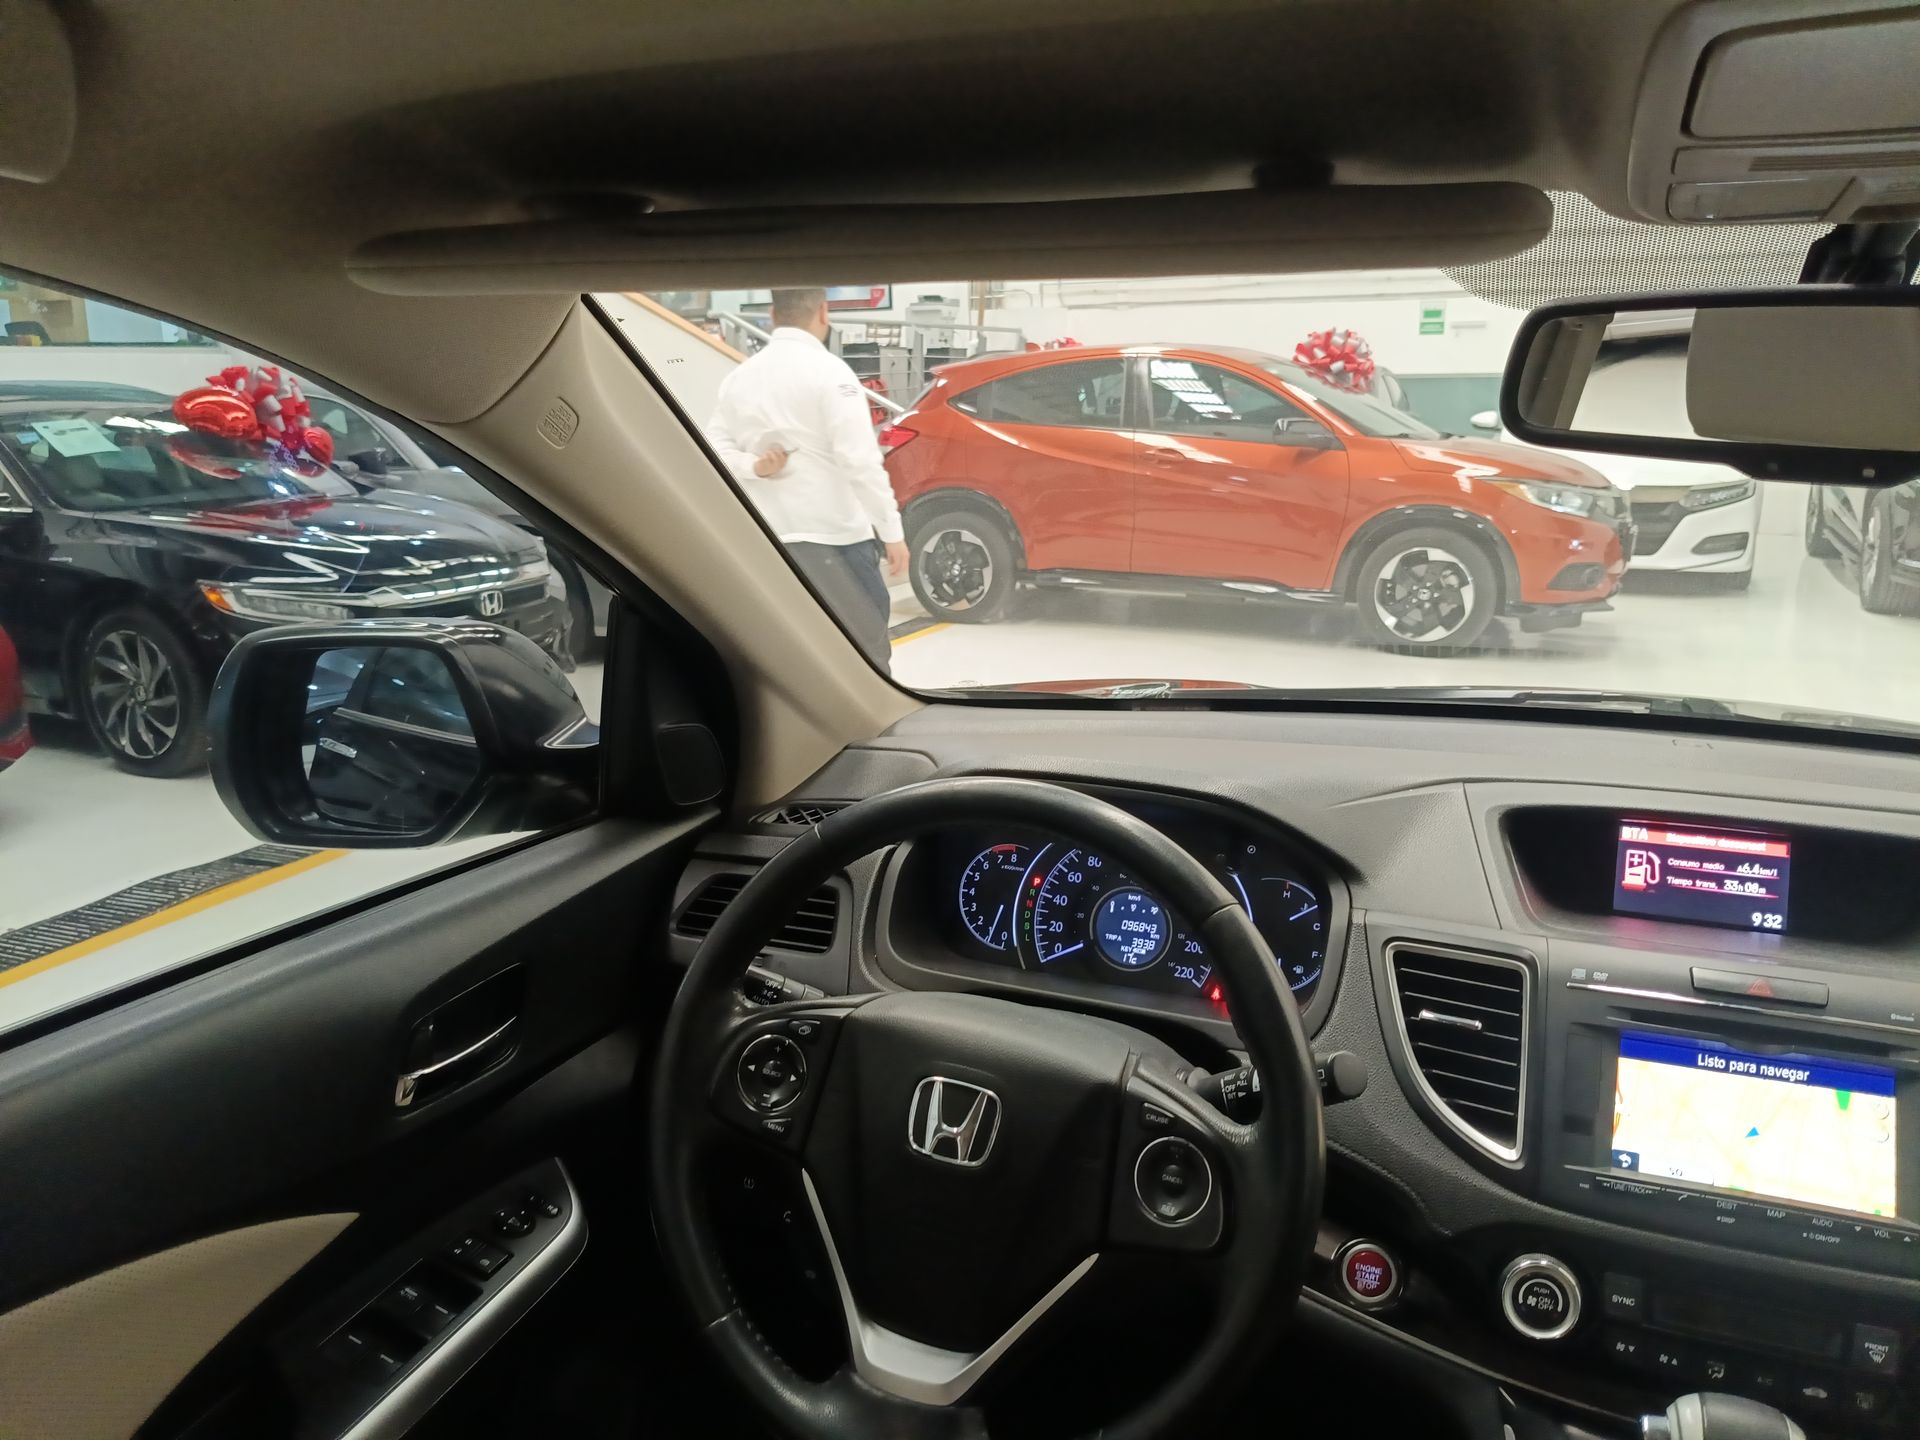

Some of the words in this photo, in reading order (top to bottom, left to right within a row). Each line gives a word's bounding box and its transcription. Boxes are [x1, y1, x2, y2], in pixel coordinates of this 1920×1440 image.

[1067, 872, 1082, 883] 60
[1053, 894, 1068, 906] 40
[1049, 920, 1063, 932] 20
[1174, 965, 1195, 979] 220
[1697, 1053, 1726, 1069] Listo
[1729, 1060, 1757, 1073] para
[1760, 1064, 1810, 1082] navegar
[767, 1122, 785, 1133] MENU
[1716, 1200, 1737, 1211] DEST
[1766, 1208, 1786, 1219] MAP
[1811, 1217, 1834, 1228] AUDIO
[1873, 1228, 1892, 1239] VOL
[1355, 1262, 1383, 1275] ENGINE
[1356, 1270, 1380, 1282] START
[1611, 1293, 1636, 1307] SYNC
